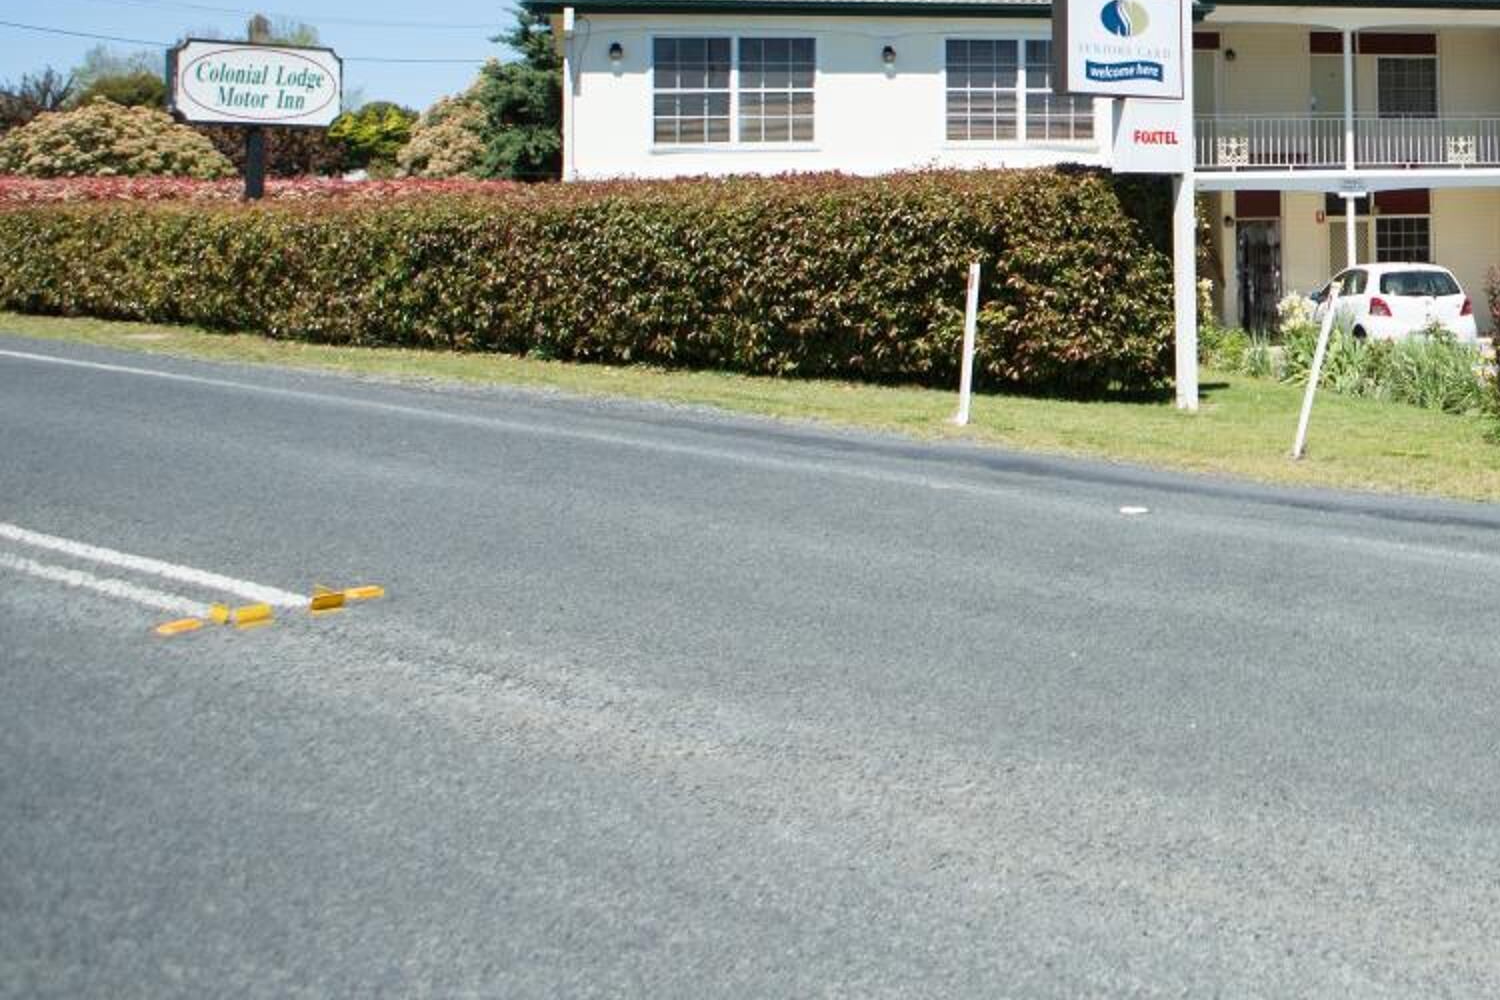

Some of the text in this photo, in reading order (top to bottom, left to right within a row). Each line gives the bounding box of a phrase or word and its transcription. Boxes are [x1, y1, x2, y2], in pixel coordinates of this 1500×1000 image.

[195, 61, 325, 91] Colonial Lodge
[1090, 63, 1160, 78] welcome here
[218, 86, 307, 110] Motor Inn
[1133, 130, 1178, 145] FOXTEL
